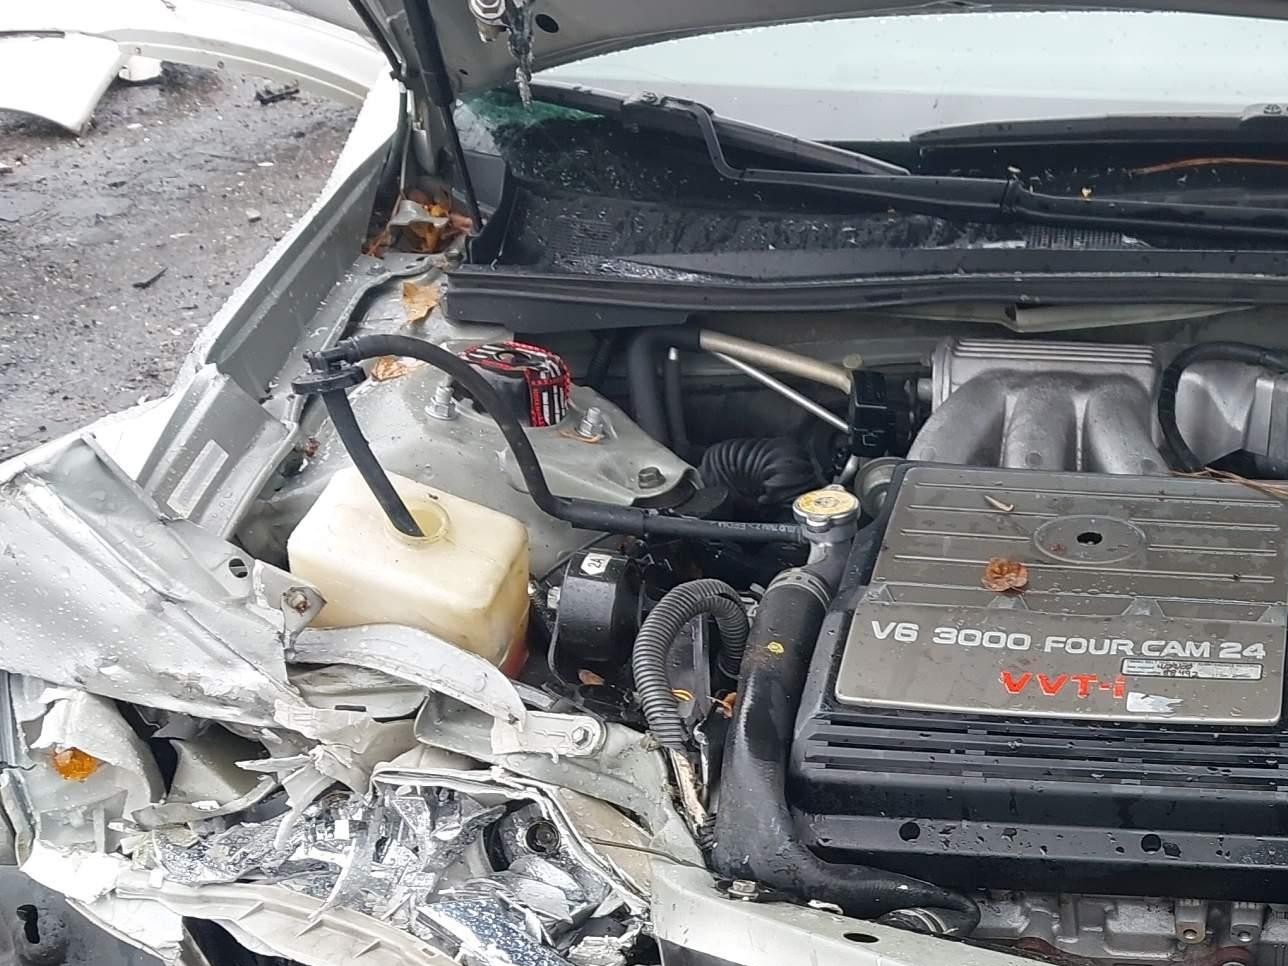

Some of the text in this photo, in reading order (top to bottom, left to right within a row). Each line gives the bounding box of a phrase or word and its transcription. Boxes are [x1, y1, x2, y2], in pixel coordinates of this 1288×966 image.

[870, 619, 1266, 660] V6 3000 FOUR CAM 24
[999, 671, 1126, 699] VVT-i
